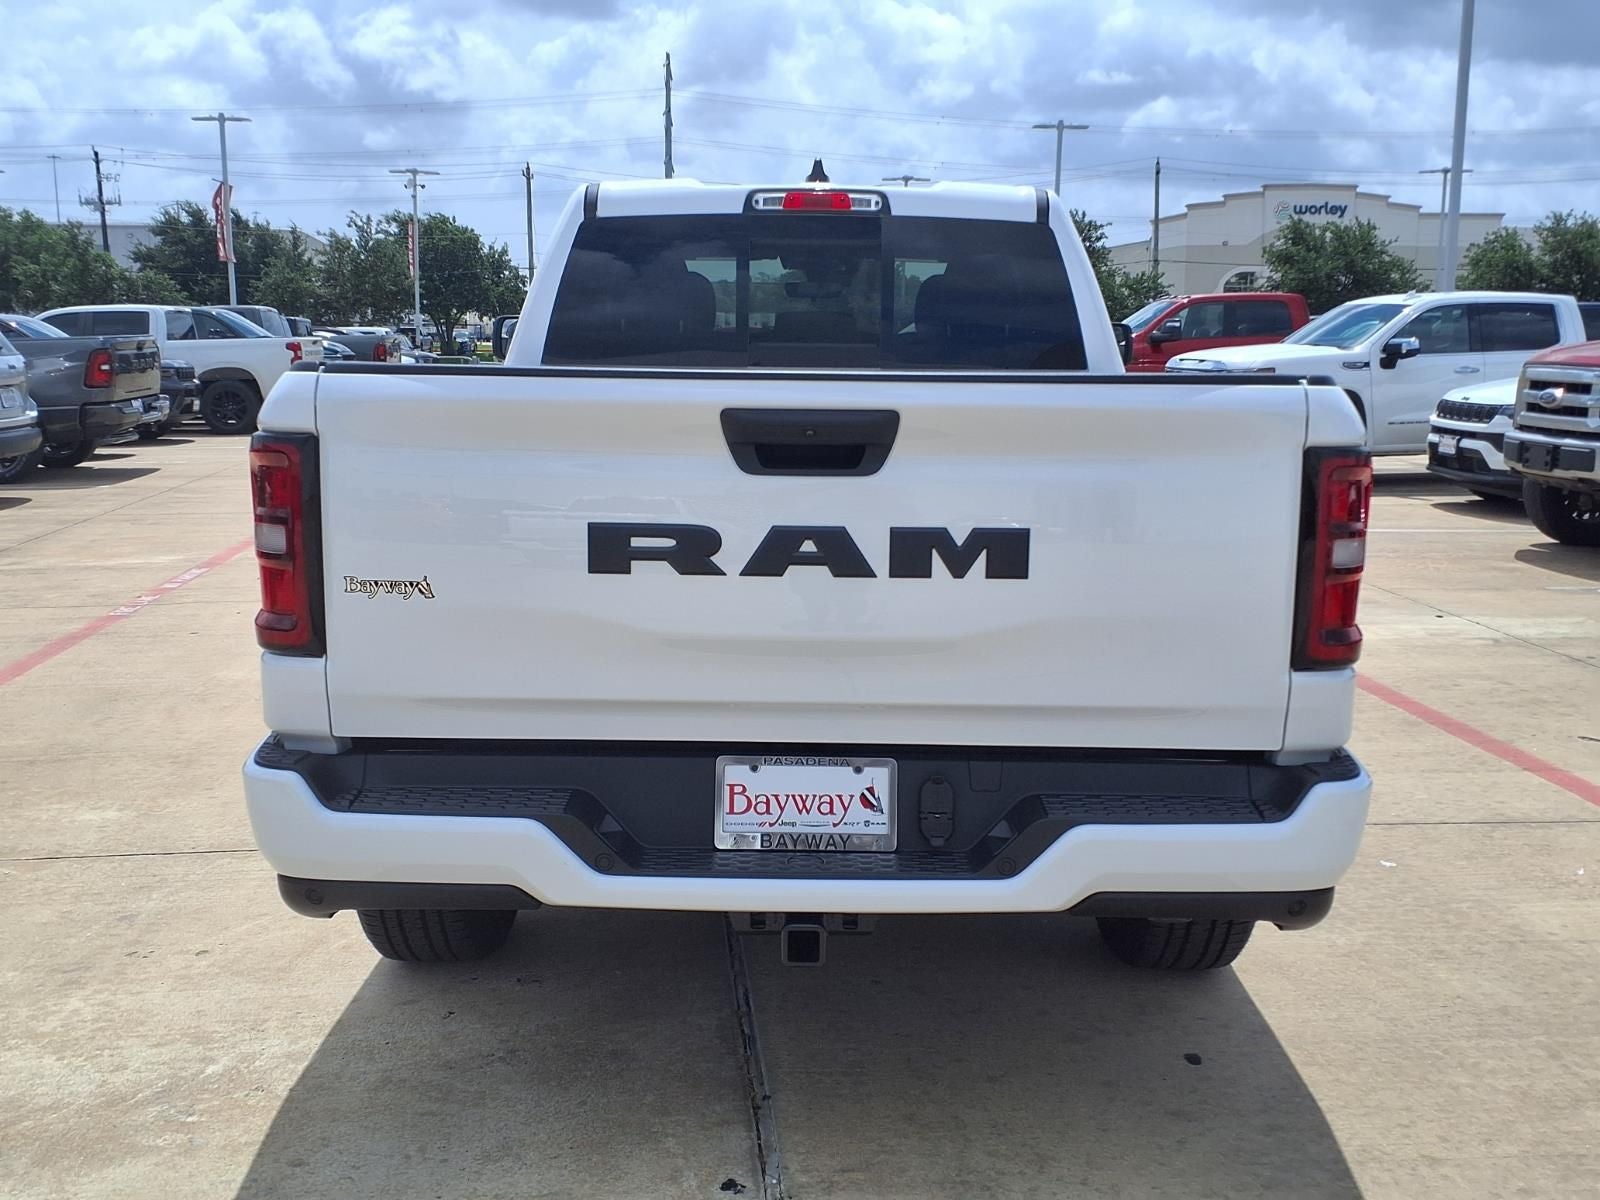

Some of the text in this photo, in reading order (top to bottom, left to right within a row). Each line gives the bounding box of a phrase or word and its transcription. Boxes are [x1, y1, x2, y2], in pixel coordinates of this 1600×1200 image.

[1293, 202, 1348, 218] worley
[588, 522, 1030, 579] RAM
[343, 576, 418, 600] Bayway
[763, 757, 850, 767] PASADENA
[725, 783, 855, 828] Bayway
[778, 819, 797, 827] Jeep
[760, 833, 851, 849] BAYWAY
